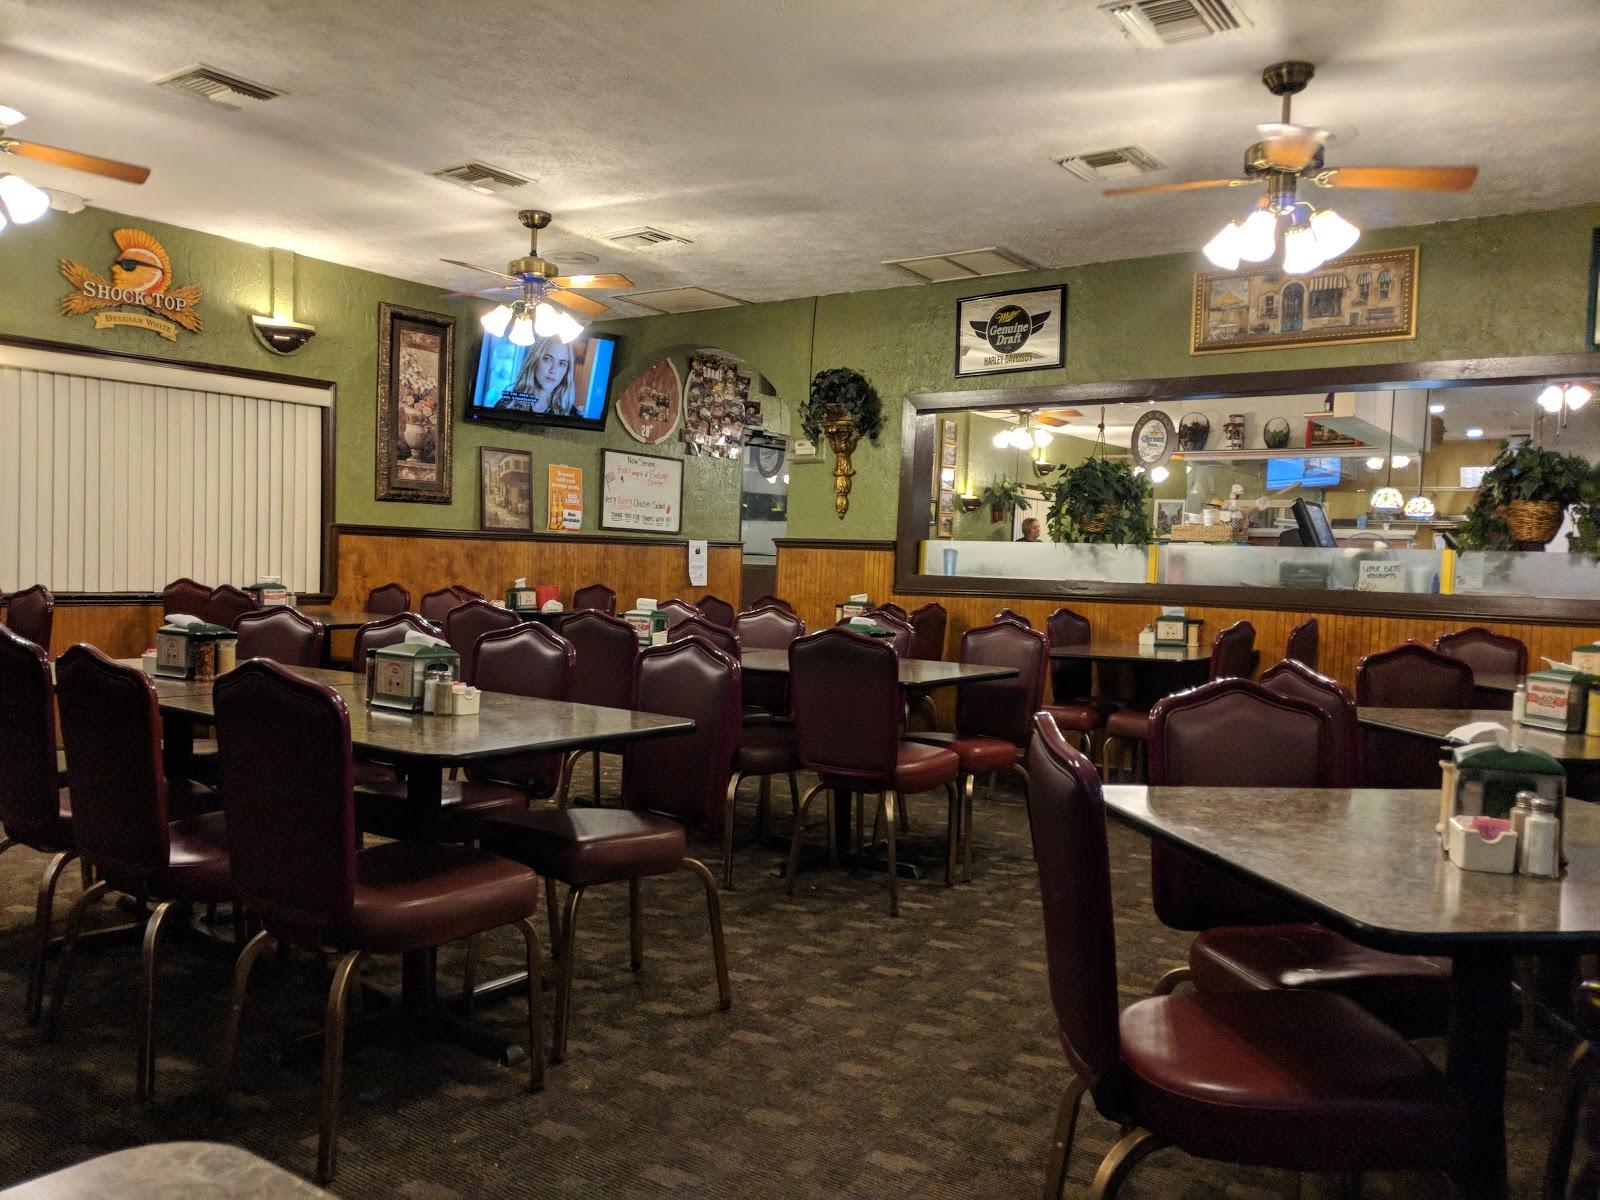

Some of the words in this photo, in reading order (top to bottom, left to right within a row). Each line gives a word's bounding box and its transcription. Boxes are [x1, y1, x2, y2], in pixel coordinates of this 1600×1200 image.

[83, 281, 146, 306] SHOCK
[152, 293, 187, 311] TOP
[105, 314, 143, 323] BELGIAN
[146, 319, 173, 334] WHITE
[990, 322, 1029, 336] Genuine
[996, 333, 1022, 346] Draft
[984, 354, 1004, 366] HARLEY
[1005, 352, 1033, 364] DAVIDSON
[627, 456, 639, 465] Now
